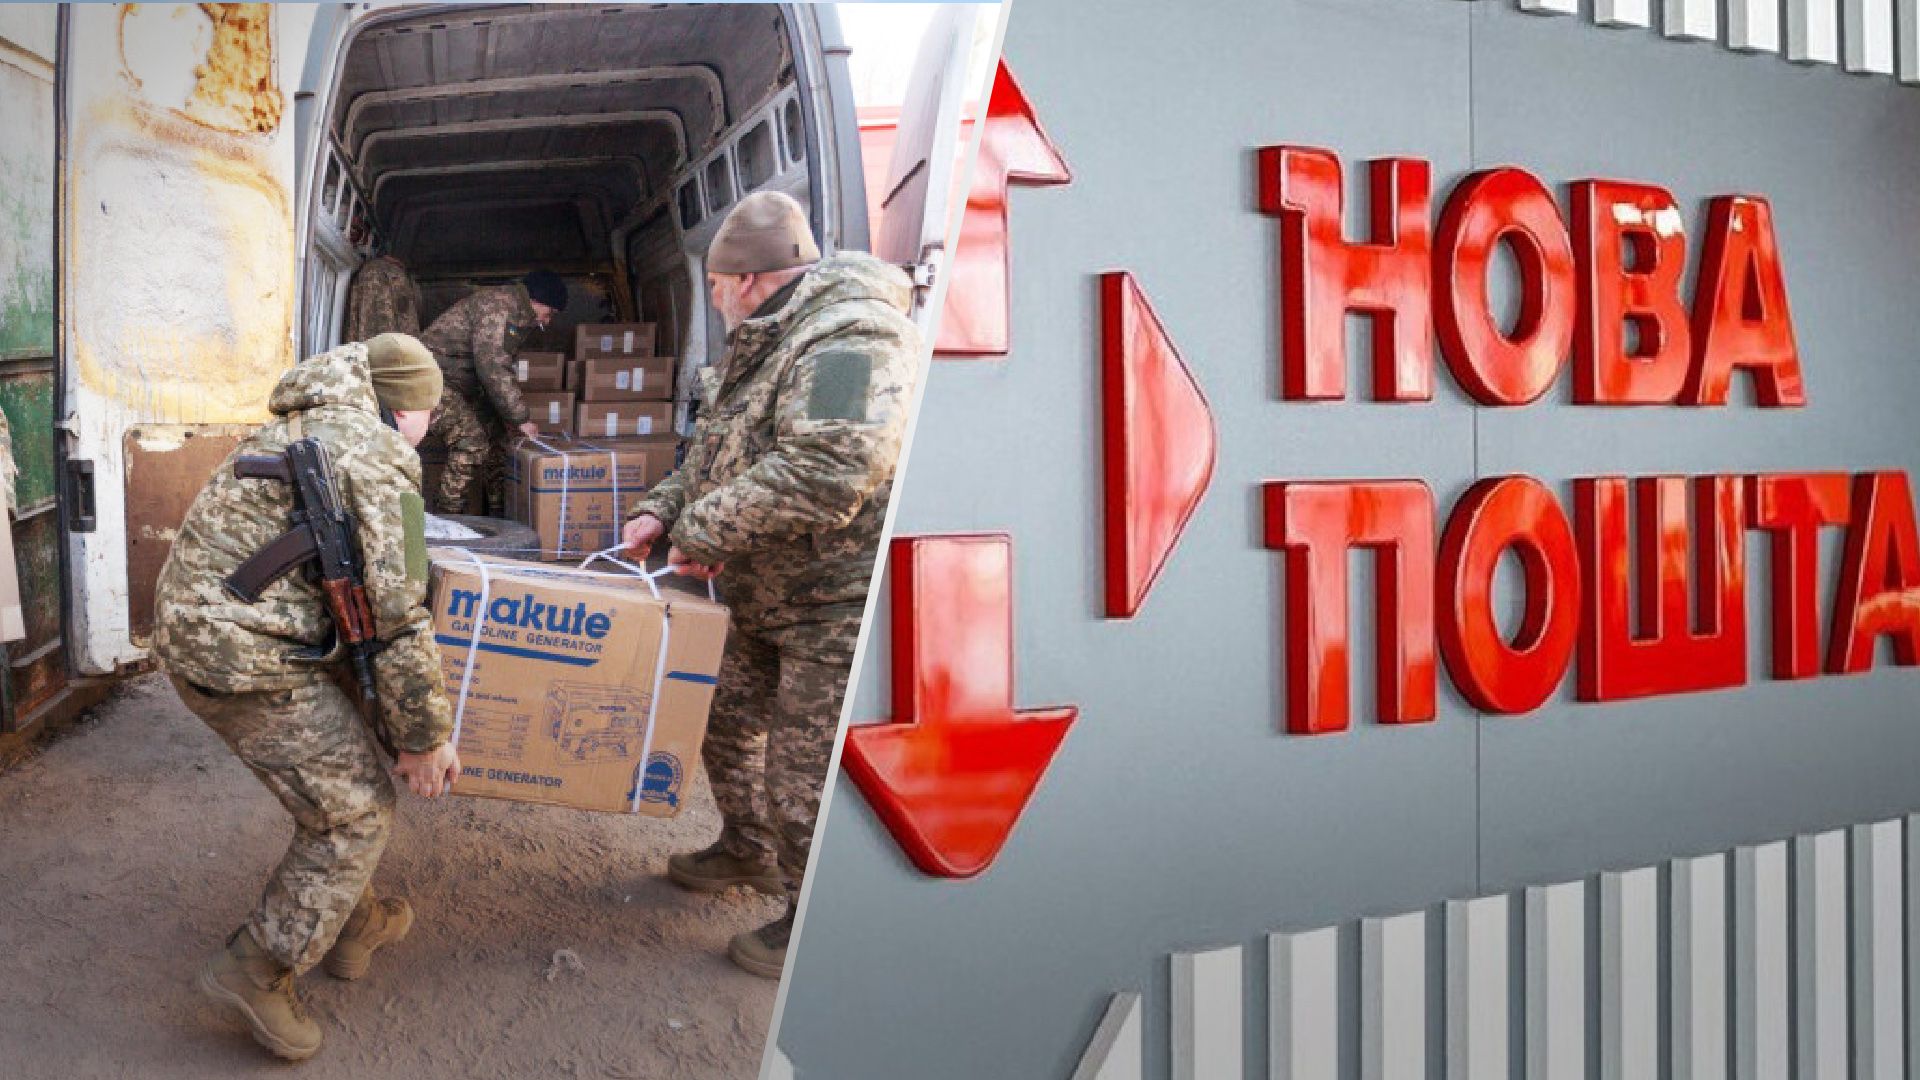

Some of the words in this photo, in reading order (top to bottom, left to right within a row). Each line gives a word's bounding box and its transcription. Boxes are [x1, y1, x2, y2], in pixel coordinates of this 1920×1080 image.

[1259, 145, 1807, 407] НОВА
[448, 588, 612, 639] makute
[1264, 470, 1920, 735] ПОШТА
[451, 619, 518, 642] GAOLINE
[526, 632, 604, 653] GENERATOR
[487, 768, 563, 788] GENERATOR
